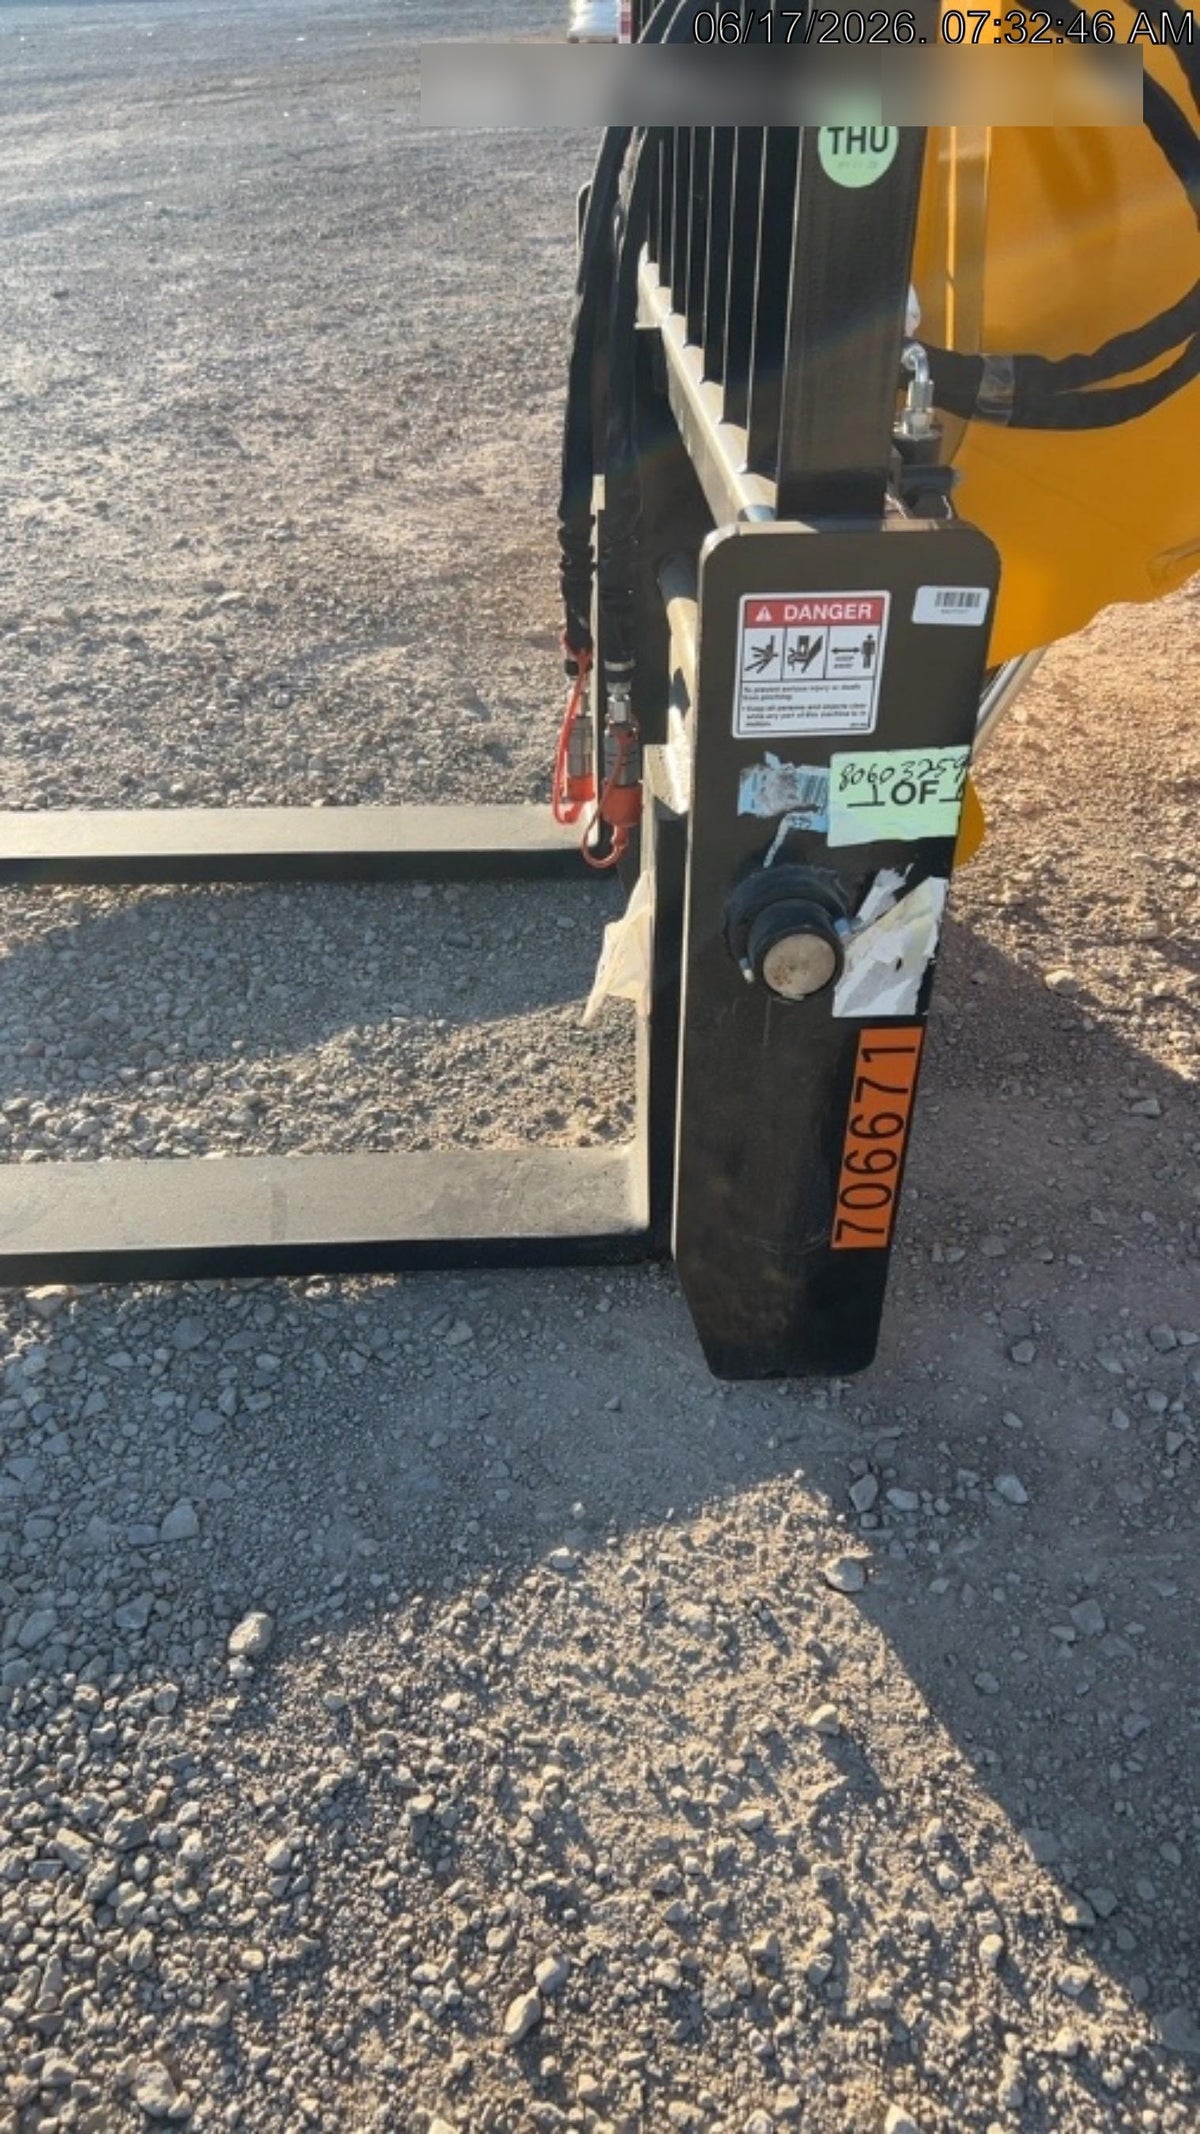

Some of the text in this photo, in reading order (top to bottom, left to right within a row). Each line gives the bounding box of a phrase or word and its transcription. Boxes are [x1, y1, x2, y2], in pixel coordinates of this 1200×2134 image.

[827, 127, 889, 154] THU
[784, 604, 872, 620] DANGER
[891, 780, 940, 805] OF
[835, 1046, 916, 1243] 706671
